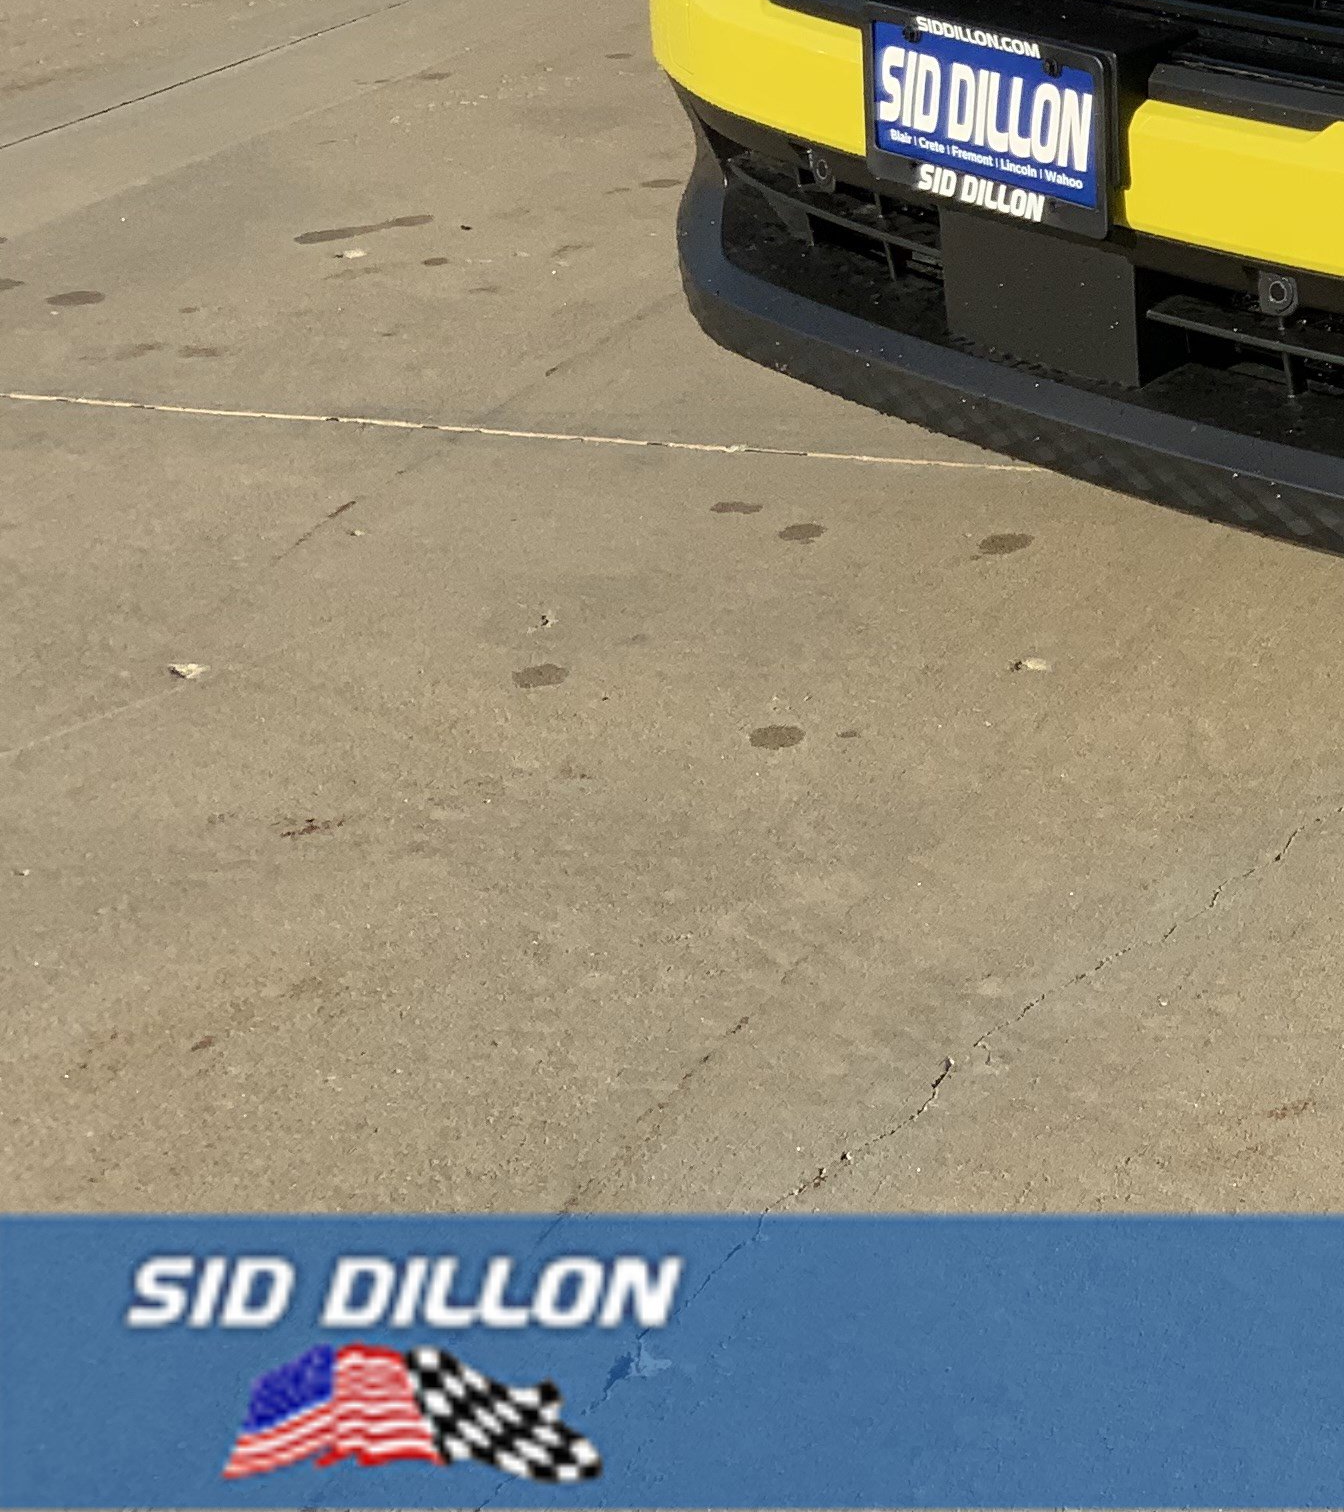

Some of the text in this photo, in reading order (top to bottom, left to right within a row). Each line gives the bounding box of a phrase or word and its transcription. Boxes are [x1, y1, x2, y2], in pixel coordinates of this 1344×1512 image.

[915, 16, 1041, 59] SIDDILLON.COM
[878, 45, 1094, 173] SID DILLON
[890, 128, 1084, 190] Blair Crete Fremont Lincoln Wahoo
[917, 163, 1046, 223] SID DILLON
